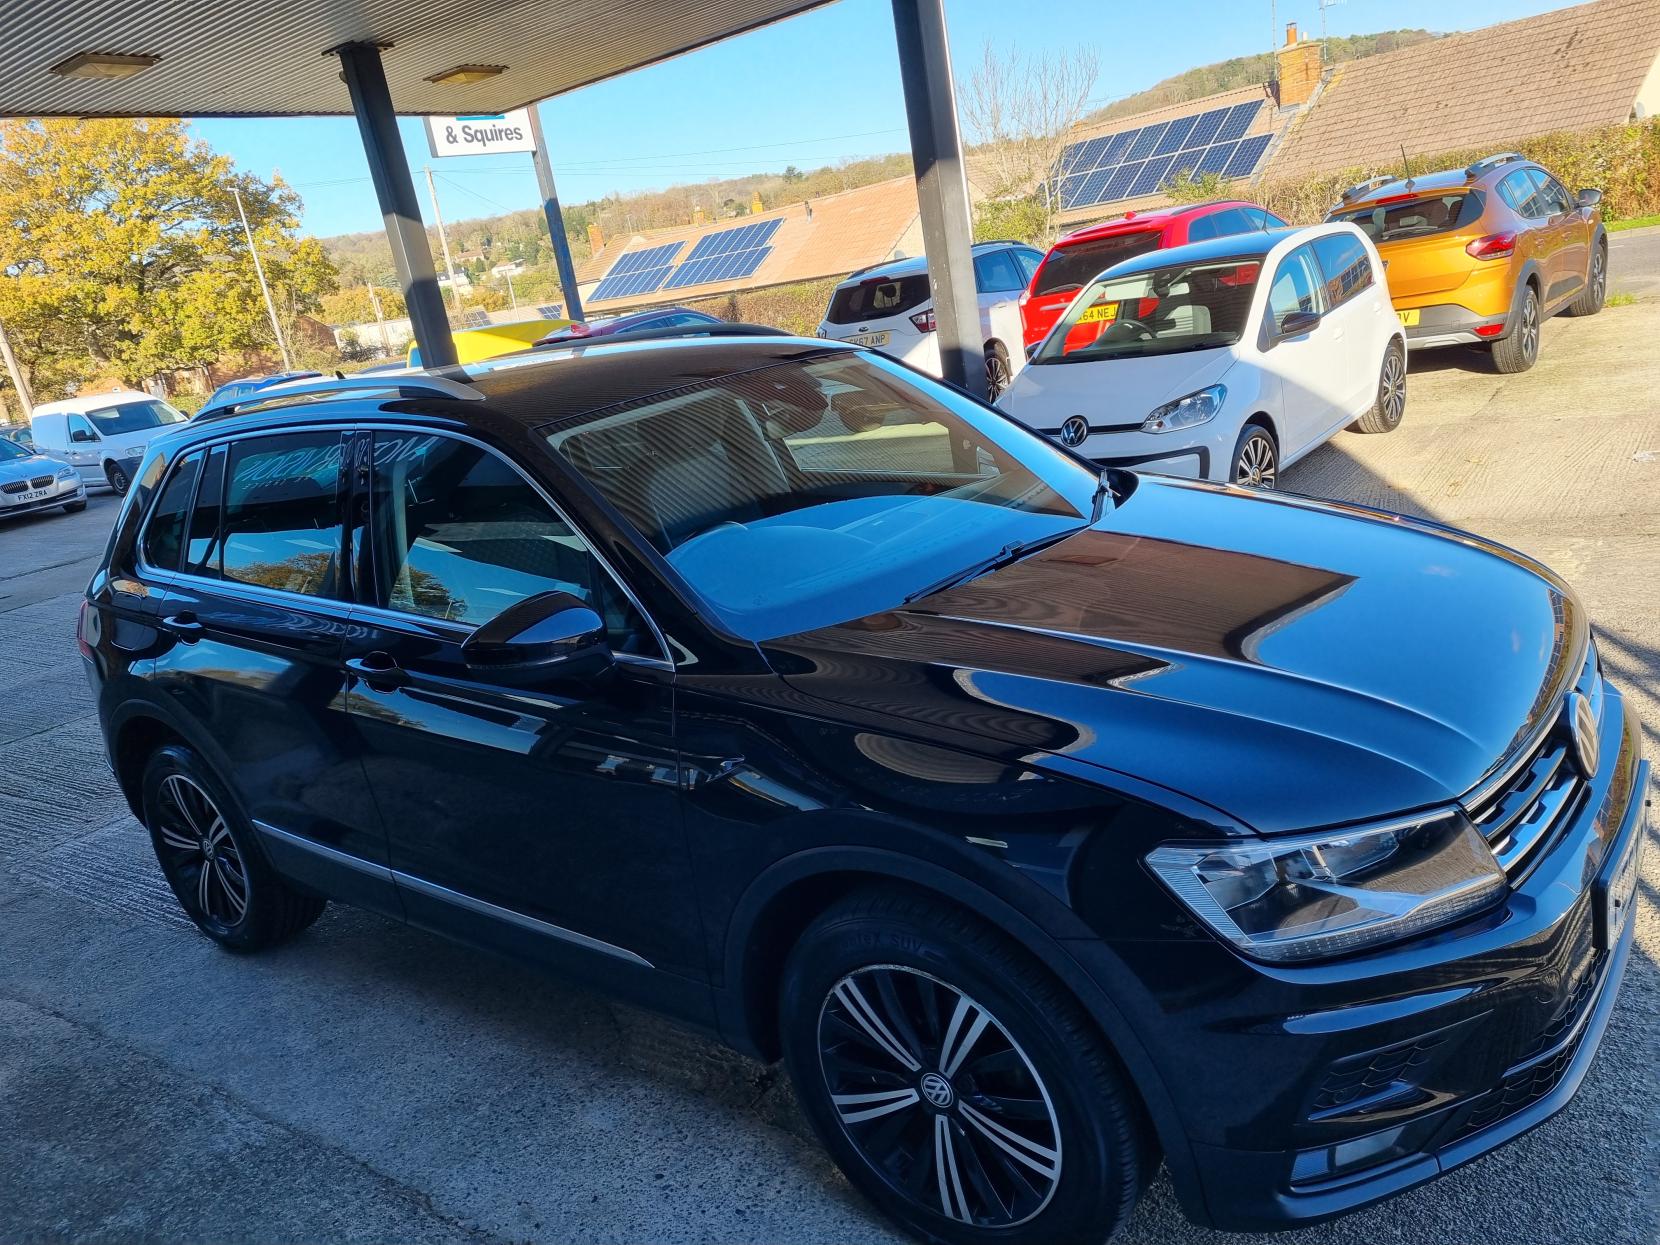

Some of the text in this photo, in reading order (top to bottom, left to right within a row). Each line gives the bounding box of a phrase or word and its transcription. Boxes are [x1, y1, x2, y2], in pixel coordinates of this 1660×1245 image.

[445, 124, 524, 147] & Squires
[1097, 306, 1117, 320] NEJ
[870, 334, 886, 345] ANP
[17, 493, 33, 502] FX12
